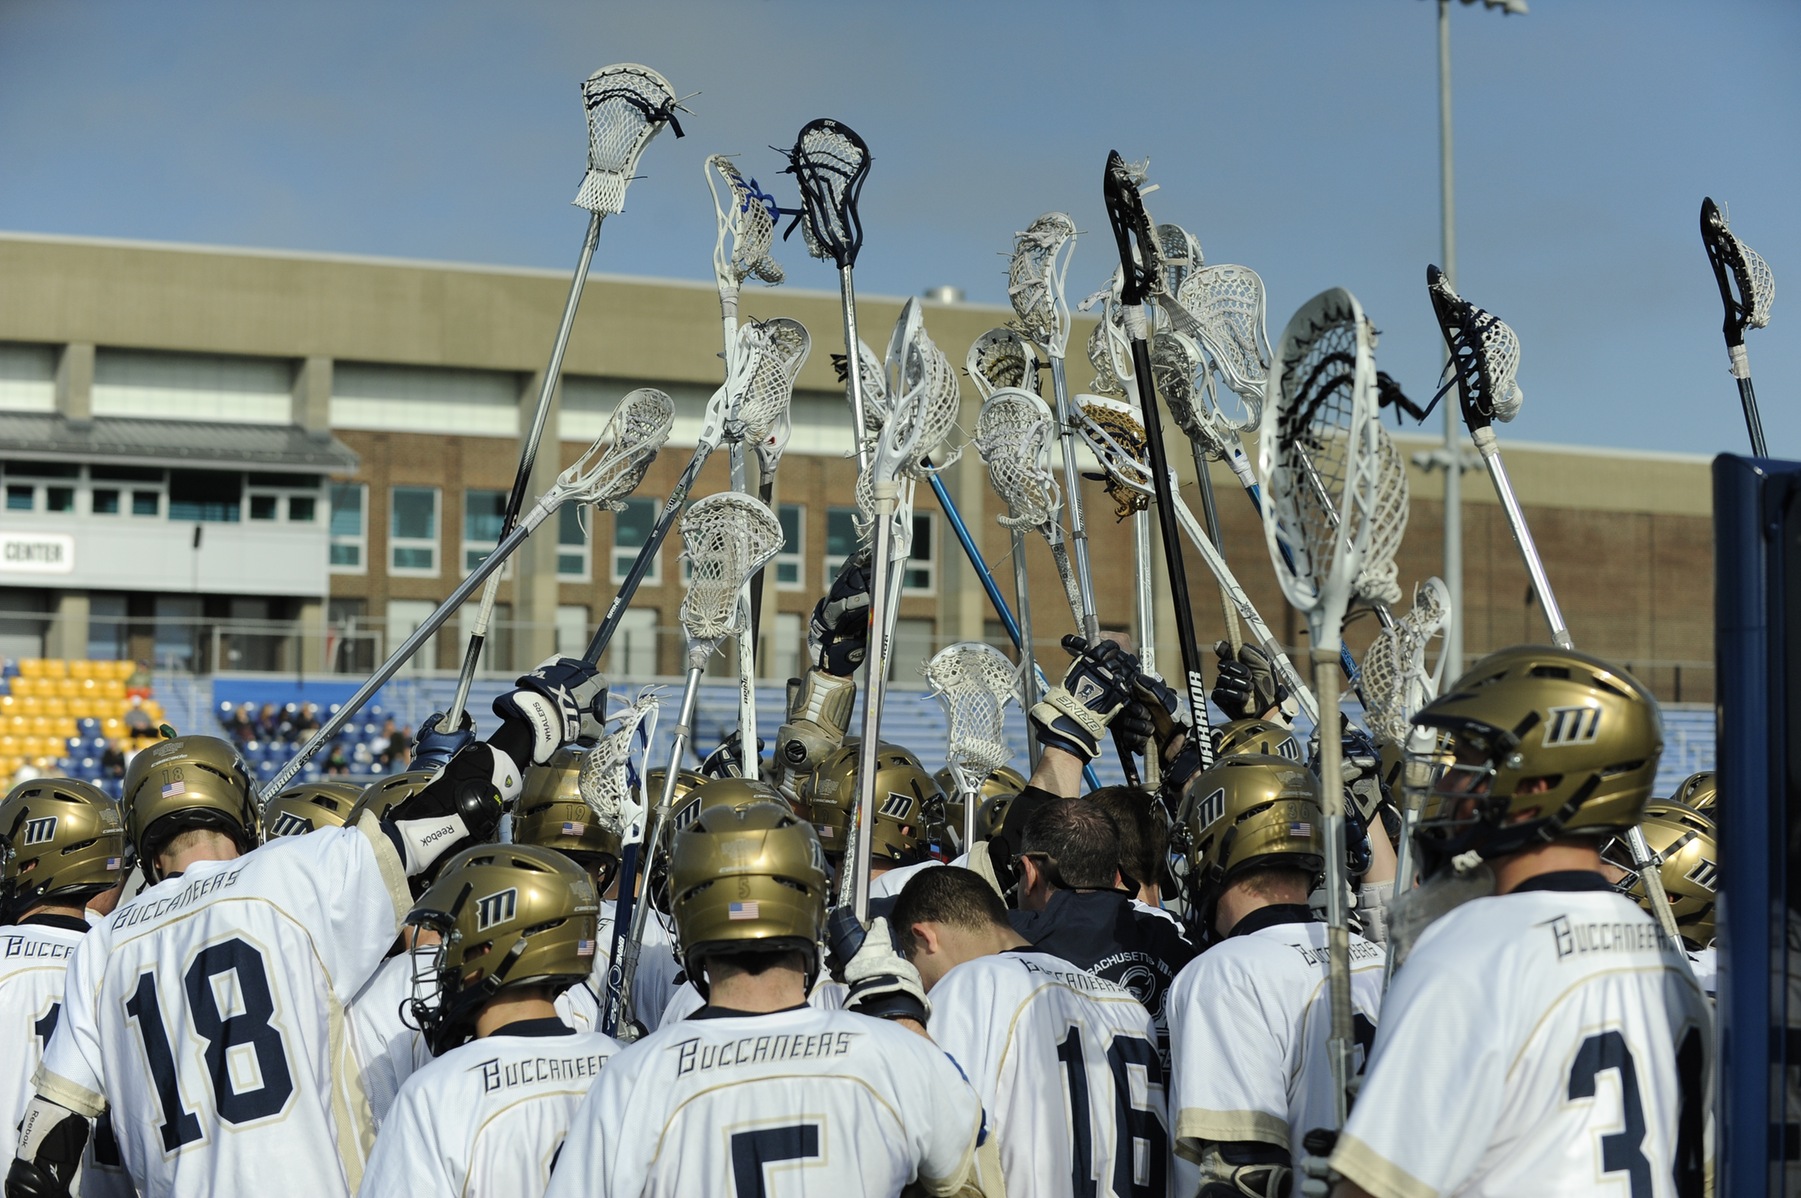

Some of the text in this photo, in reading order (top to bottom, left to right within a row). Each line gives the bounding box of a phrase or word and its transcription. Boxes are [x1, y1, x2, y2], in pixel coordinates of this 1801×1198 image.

[4, 541, 63, 563] CENTER
[533, 701, 552, 742] WHALERS
[1056, 695, 1102, 732] BRINE
[162, 767, 184, 785] 18
[566, 804, 586, 821] 19
[420, 824, 455, 847] Reebok
[112, 864, 249, 932] BUCCANEERS
[738, 877, 751, 899] 5
[616, 934, 626, 967] BRINE
[1533, 913, 1676, 962] BUCCANEER
[122, 932, 297, 1158] 18
[665, 1031, 868, 1077] BUCCANEERS
[21, 1110, 39, 1148] Reebok
